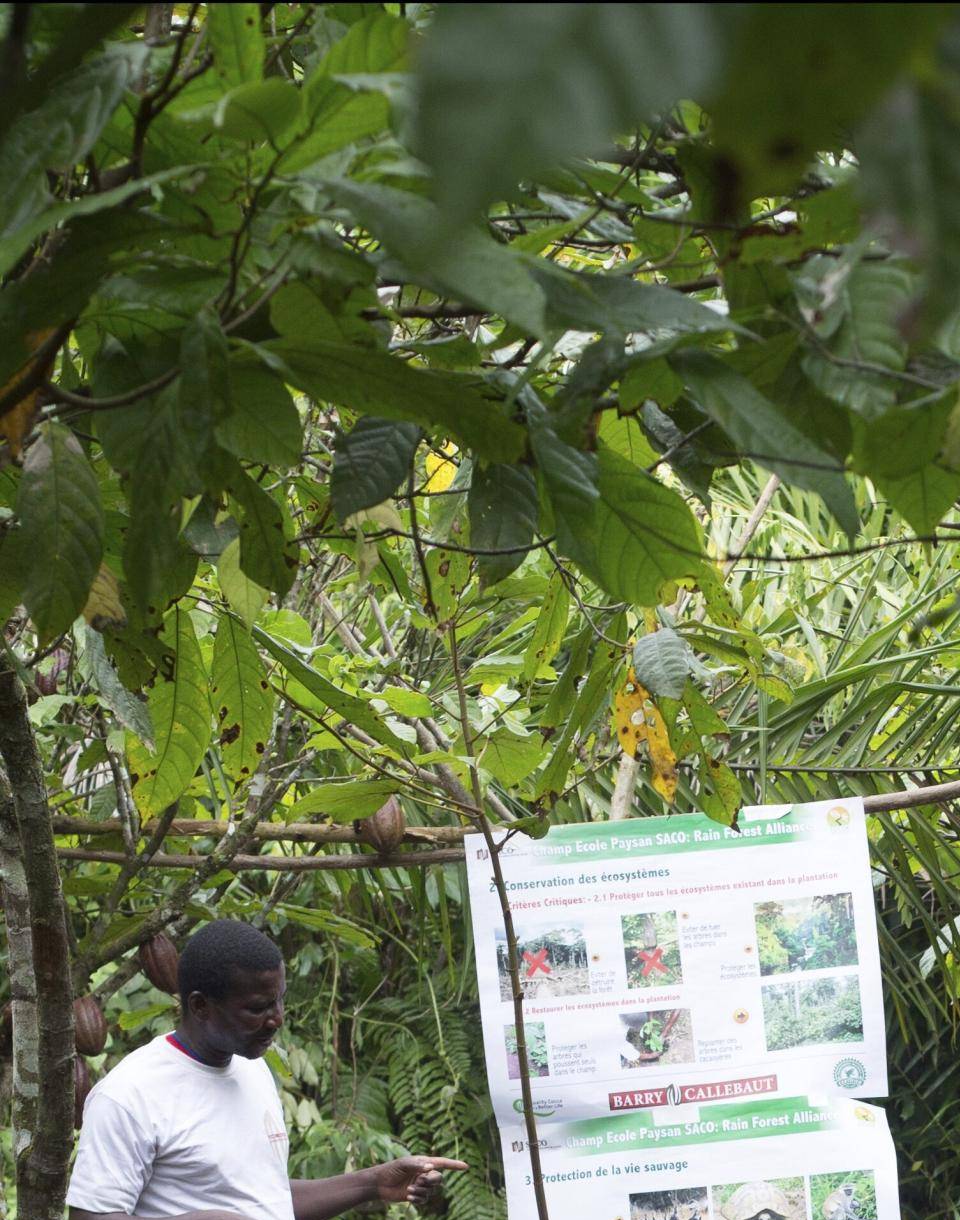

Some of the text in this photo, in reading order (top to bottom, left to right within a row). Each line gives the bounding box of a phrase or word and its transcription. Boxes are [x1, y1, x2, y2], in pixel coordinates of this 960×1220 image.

[533, 844, 571, 857] Champ
[576, 840, 608, 853] Ecole
[611, 836, 652, 850] Paysan
[656, 831, 690, 846] SACO:
[694, 828, 721, 842] Rain
[724, 824, 762, 839] Forest
[504, 876, 574, 891] Conservation
[578, 874, 597, 885] des
[601, 868, 670, 883] écosystèmes
[647, 890, 664, 898] tous
[667, 887, 679, 896] les
[733, 880, 764, 889] existant
[767, 878, 785, 886] dans
[797, 872, 838, 886] plantation
[532, 1004, 564, 1014] Restaurer
[566, 1003, 575, 1011] les
[621, 998, 636, 1006] dans
[646, 994, 681, 1006] plantation
[613, 1077, 774, 1107] BARRY CALLEBAUT
[566, 1137, 603, 1149] Champ
[606, 1131, 636, 1144] Ecole
[640, 1126, 681, 1142] Paysan
[685, 1121, 718, 1135] SACO:
[723, 1118, 748, 1131] Rain
[752, 1114, 790, 1128] Forest
[595, 1166, 608, 1177] de
[612, 1165, 621, 1175] la
[624, 1162, 640, 1173] vie
[644, 1160, 688, 1176] sauvage
